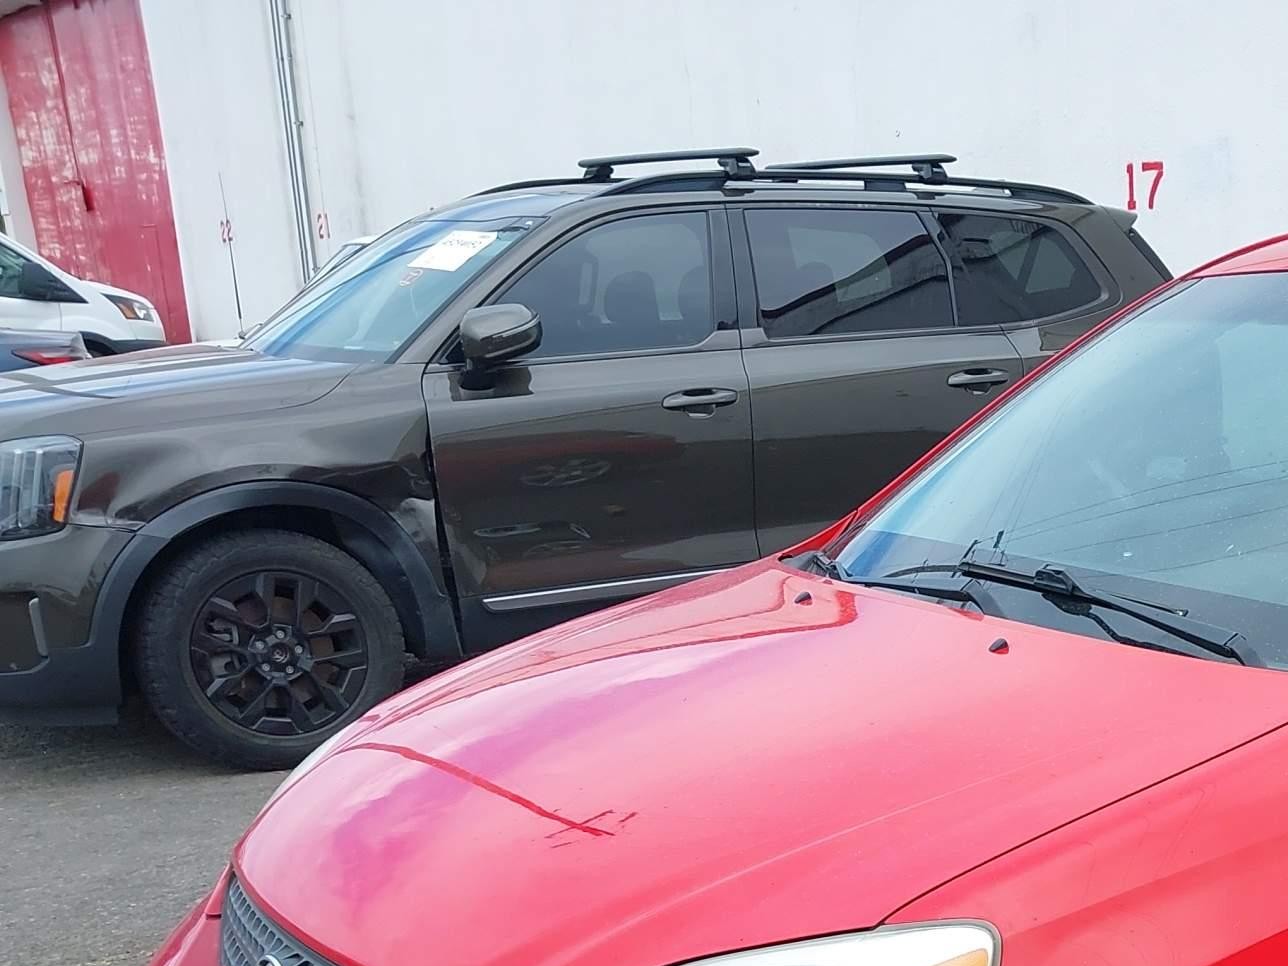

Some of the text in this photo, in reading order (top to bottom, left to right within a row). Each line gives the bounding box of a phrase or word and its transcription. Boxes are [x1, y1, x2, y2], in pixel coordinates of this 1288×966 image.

[1126, 161, 1164, 210] 17
[220, 219, 233, 243] 22
[317, 212, 332, 239] 21
